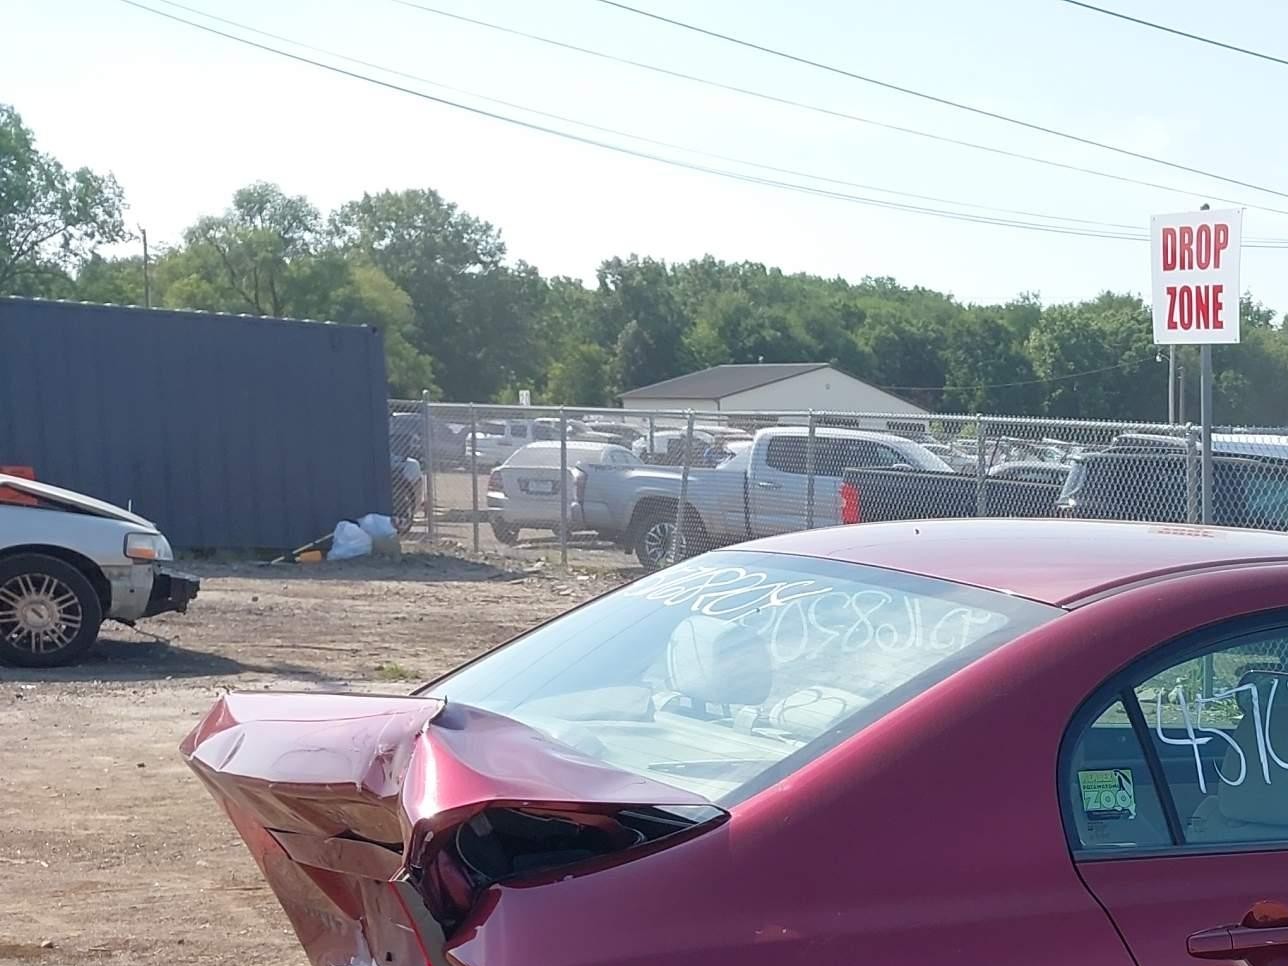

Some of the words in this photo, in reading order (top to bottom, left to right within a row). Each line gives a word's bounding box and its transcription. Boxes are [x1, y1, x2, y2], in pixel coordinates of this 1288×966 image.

[1162, 223, 1229, 272] DROP
[1166, 284, 1224, 331] ZONE
[624, 566, 833, 627] 5768204
[1084, 790, 1131, 809] ZOO
